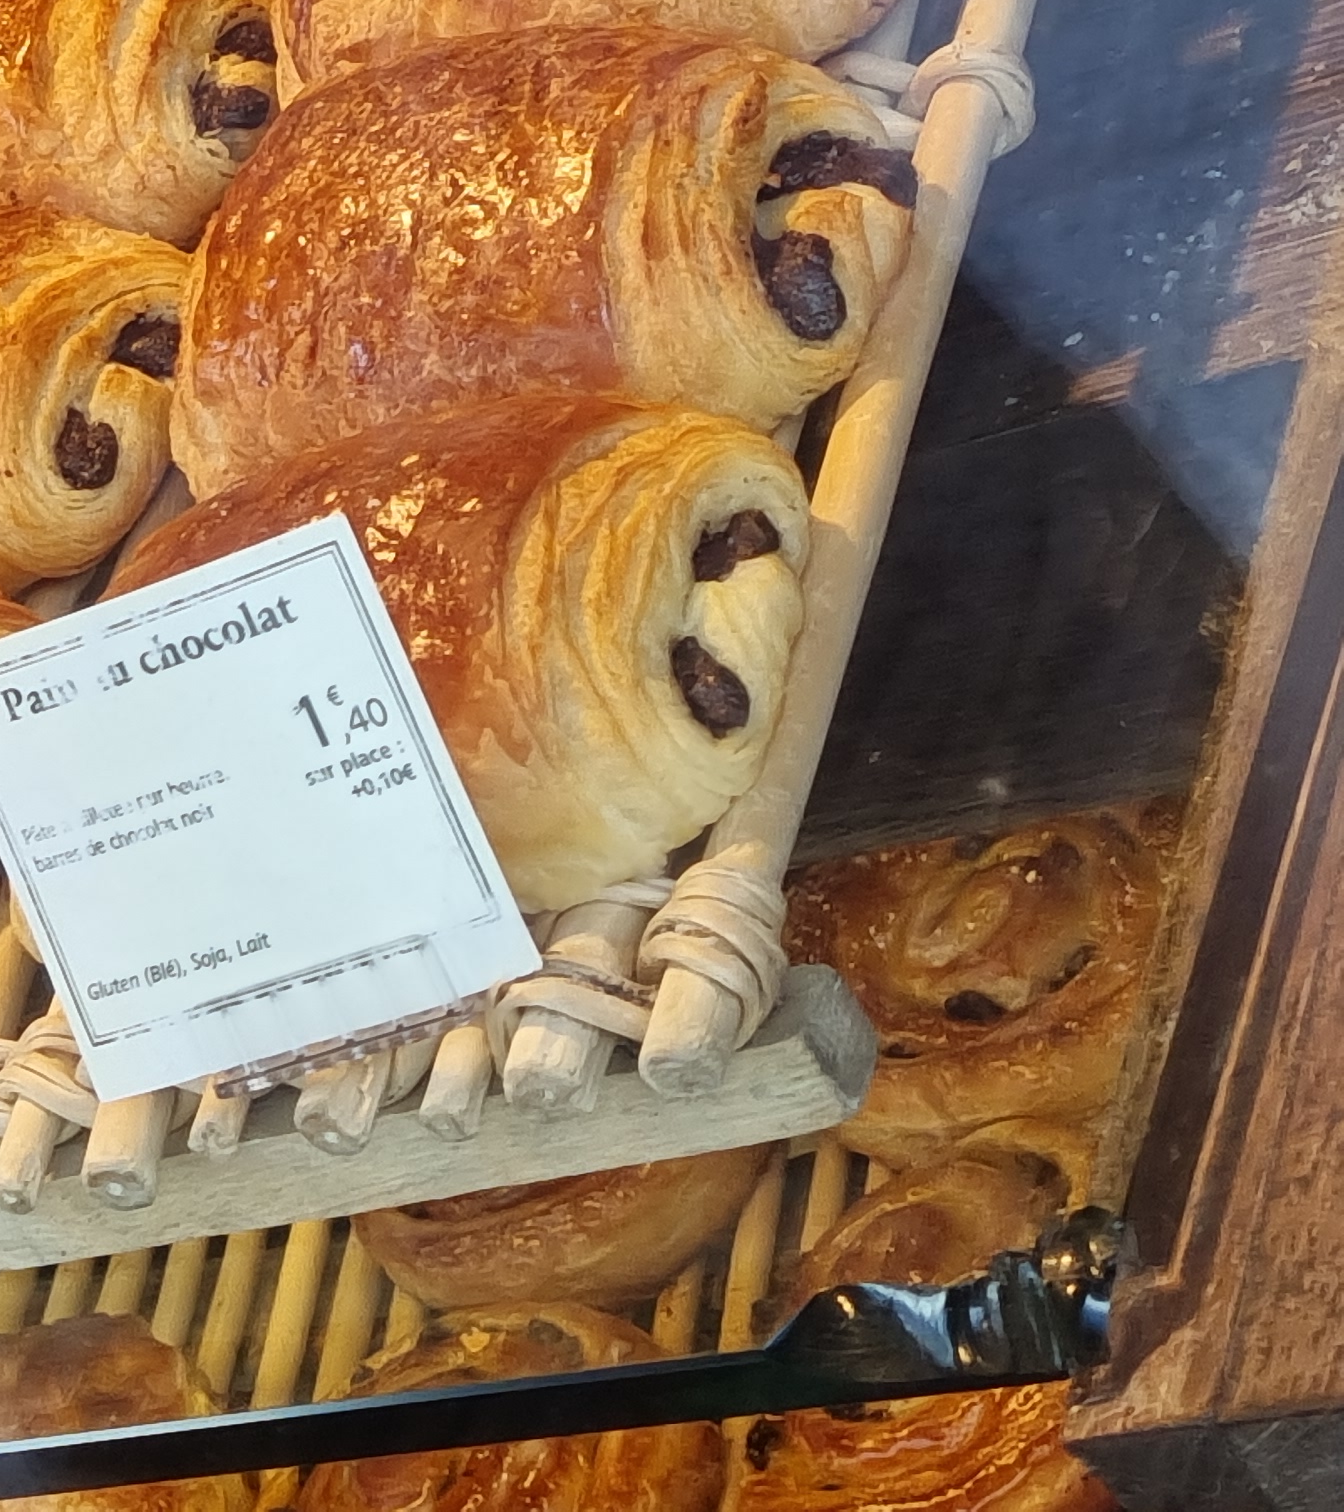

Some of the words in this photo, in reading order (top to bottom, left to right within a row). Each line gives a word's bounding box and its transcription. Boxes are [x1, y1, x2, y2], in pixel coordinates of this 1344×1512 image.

[139, 595, 299, 675] chocolat
[305, 765, 335, 786] sur
[340, 745, 392, 778] place
[352, 762, 417, 797] +0,10€
[32, 847, 83, 873] barres
[87, 838, 107, 857] de
[110, 817, 179, 850] chocolat
[87, 974, 140, 1001] Gluten
[144, 958, 187, 987] (Blé),
[190, 946, 233, 971] Soja,
[236, 932, 271, 957] Lait
